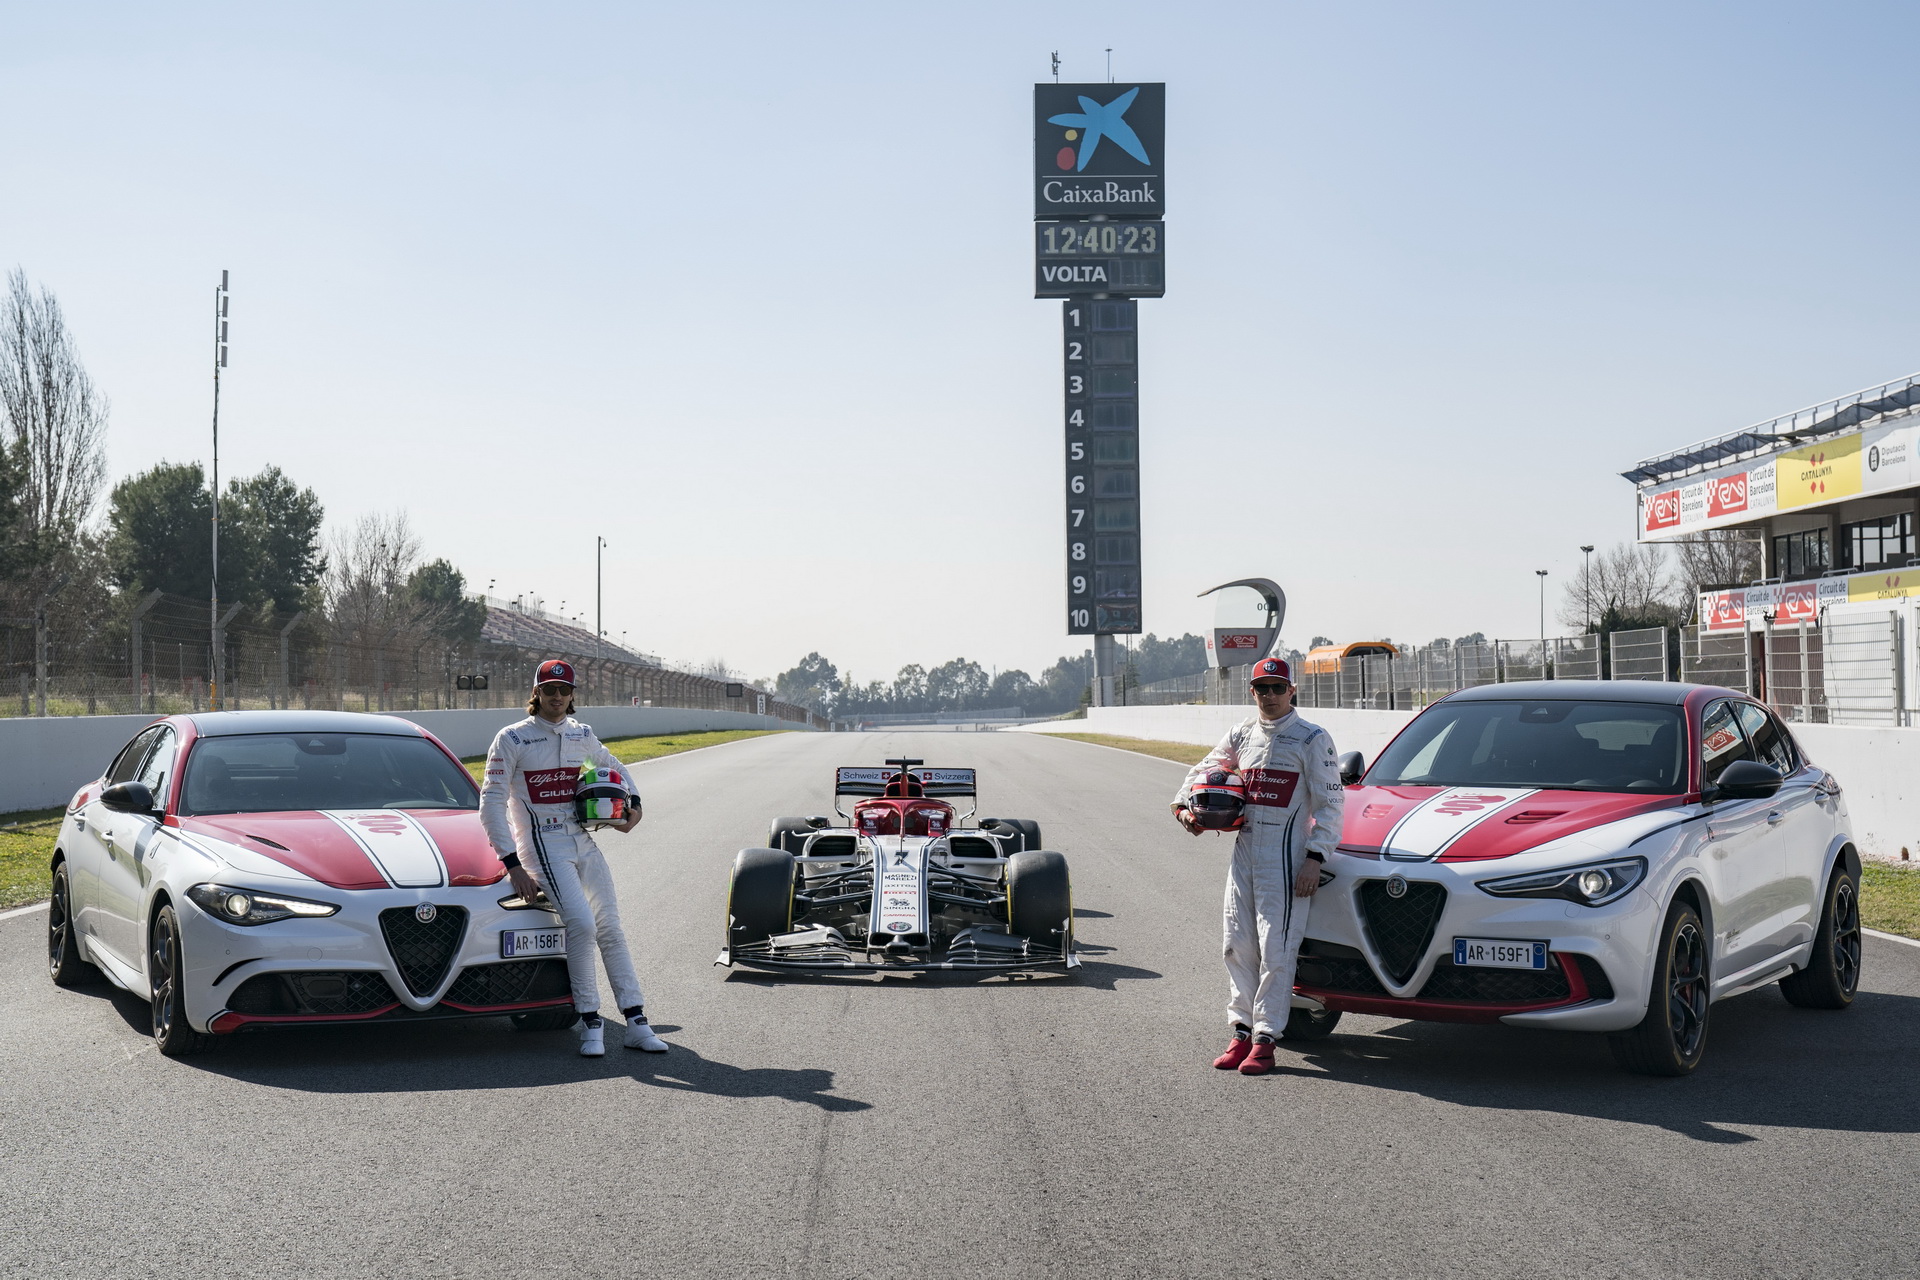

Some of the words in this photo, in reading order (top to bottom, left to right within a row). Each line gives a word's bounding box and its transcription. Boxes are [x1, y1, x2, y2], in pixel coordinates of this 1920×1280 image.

[1043, 181, 1156, 203] CaixaBank
[1043, 226, 1156, 254] 12:40:23
[1042, 266, 1107, 282] VOLTA
[1069, 309, 1080, 327] 1
[1069, 342, 1082, 360] 2
[1070, 375, 1083, 393] 3
[1069, 409, 1084, 427] 4
[1071, 442, 1084, 460] 5
[1881, 456, 1906, 467] Barcelona
[1749, 468, 1766, 482] Circuit
[1767, 465, 1774, 478] de
[1801, 465, 1832, 481] CATALUNYA
[1071, 475, 1085, 494] 6
[1682, 486, 1697, 499] Circuit
[1697, 484, 1703, 496] de
[1749, 481, 1774, 496] Barcelona
[1682, 499, 1703, 512] Barcelona
[1071, 509, 1085, 527] 7
[1071, 542, 1086, 561] 8
[1072, 576, 1086, 594] 9
[1819, 583, 1837, 594] Circuit
[1839, 582, 1846, 592] de
[1747, 590, 1761, 603] Circuit
[1763, 591, 1769, 601] de
[1878, 589, 1908, 599] CATALUNYA
[1071, 609, 1089, 627] 10
[529, 773, 554, 786] Alfa
[843, 772, 879, 780] Schweiz
[935, 772, 970, 780] Svizzera
[1257, 771, 1290, 784] Romeo
[540, 789, 574, 797] GIULIA
[894, 851, 909, 866] 7
[516, 936, 528, 950] AR
[534, 934, 563, 949] 158F1
[1468, 945, 1484, 961] AR
[1491, 946, 1530, 963] 159F1
